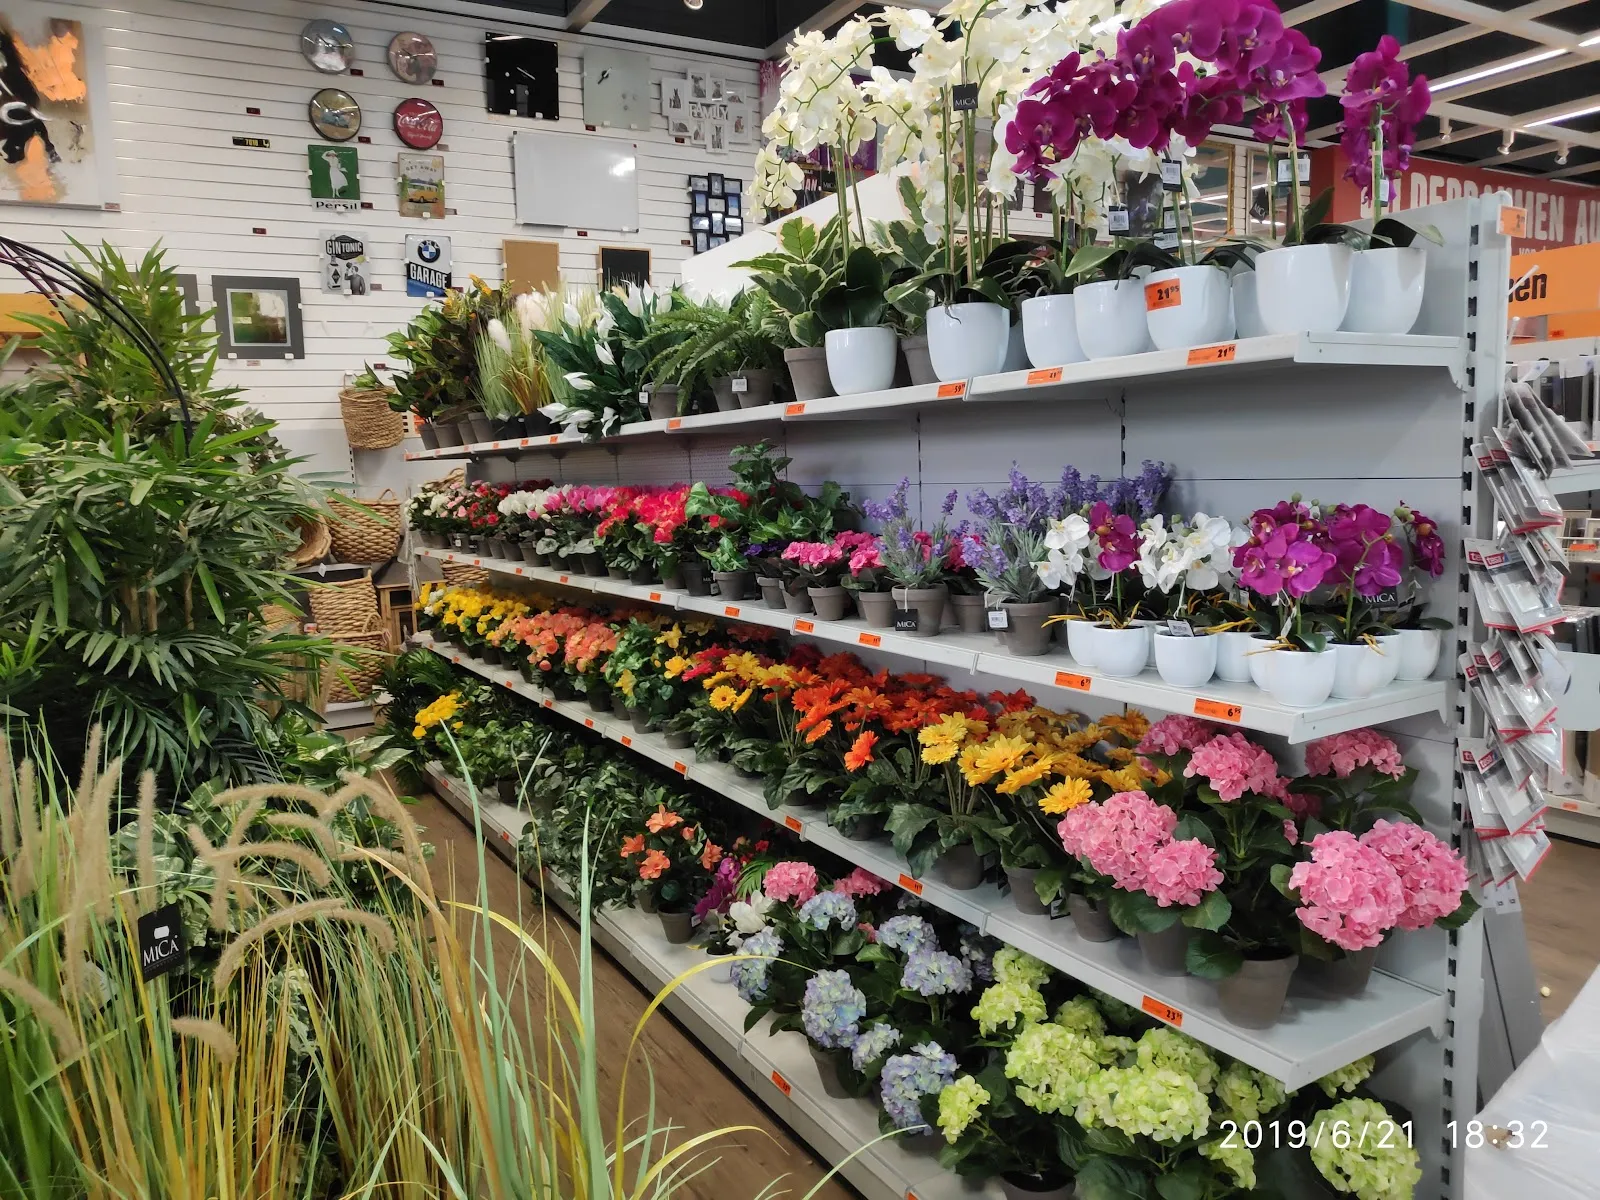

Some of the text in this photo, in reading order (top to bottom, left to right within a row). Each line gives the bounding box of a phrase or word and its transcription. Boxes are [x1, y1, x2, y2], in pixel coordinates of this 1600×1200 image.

[955, 98, 976, 106] MICA
[689, 103, 728, 120] FAMILY
[316, 200, 358, 210] Persil
[326, 240, 363, 255] GIN TONIC
[410, 264, 448, 289] GARAGE
[1365, 593, 1395, 604] MICA
[896, 620, 916, 629] MICA
[143, 939, 179, 967] MICA
